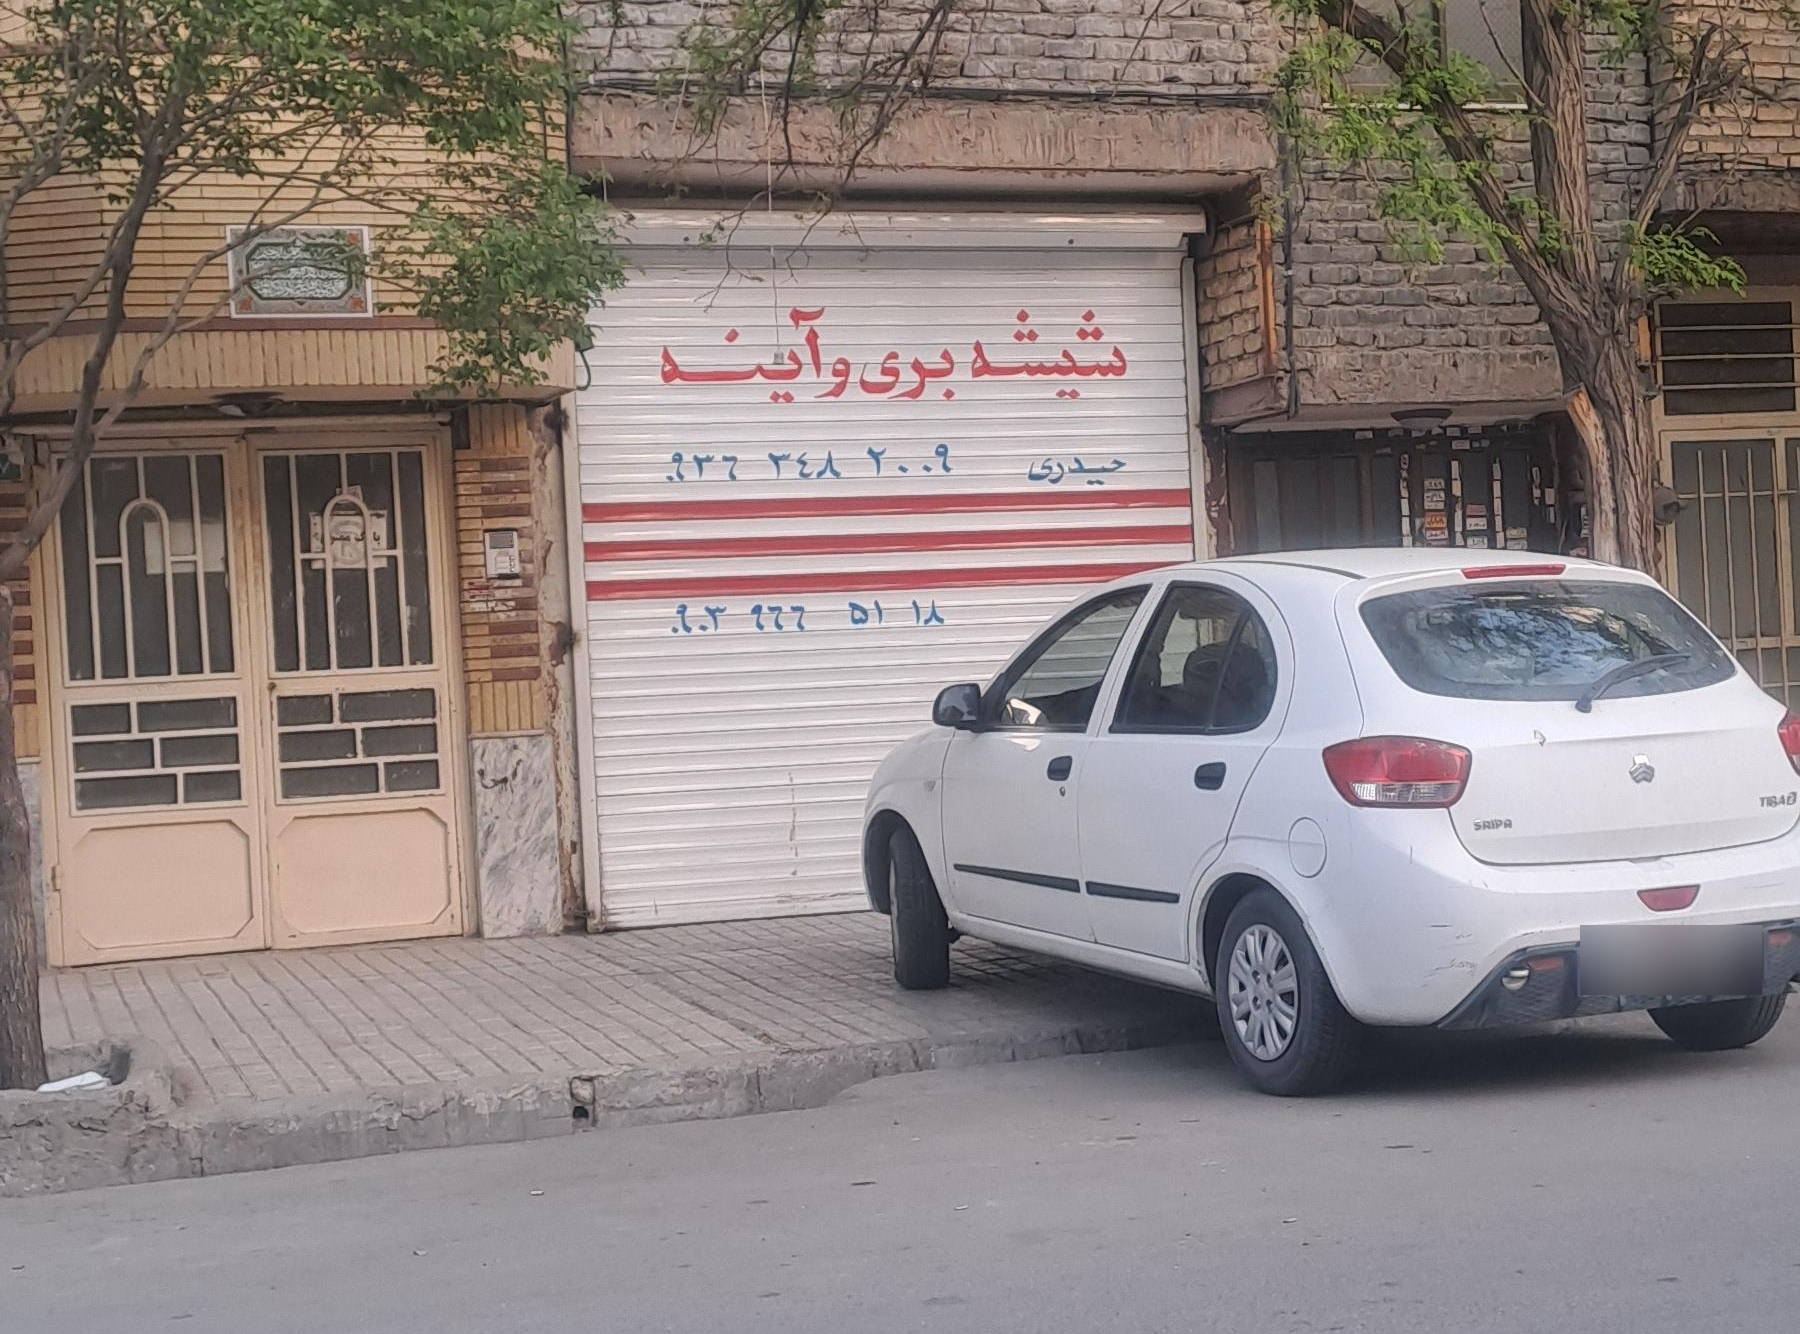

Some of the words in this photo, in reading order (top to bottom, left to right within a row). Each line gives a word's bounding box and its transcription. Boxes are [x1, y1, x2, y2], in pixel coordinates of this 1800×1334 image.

[858, 343, 956, 401] بری
[970, 309, 1128, 400] شیشه
[1027, 455, 1128, 486] حیدری
[1472, 818, 1513, 831] SAIPA
